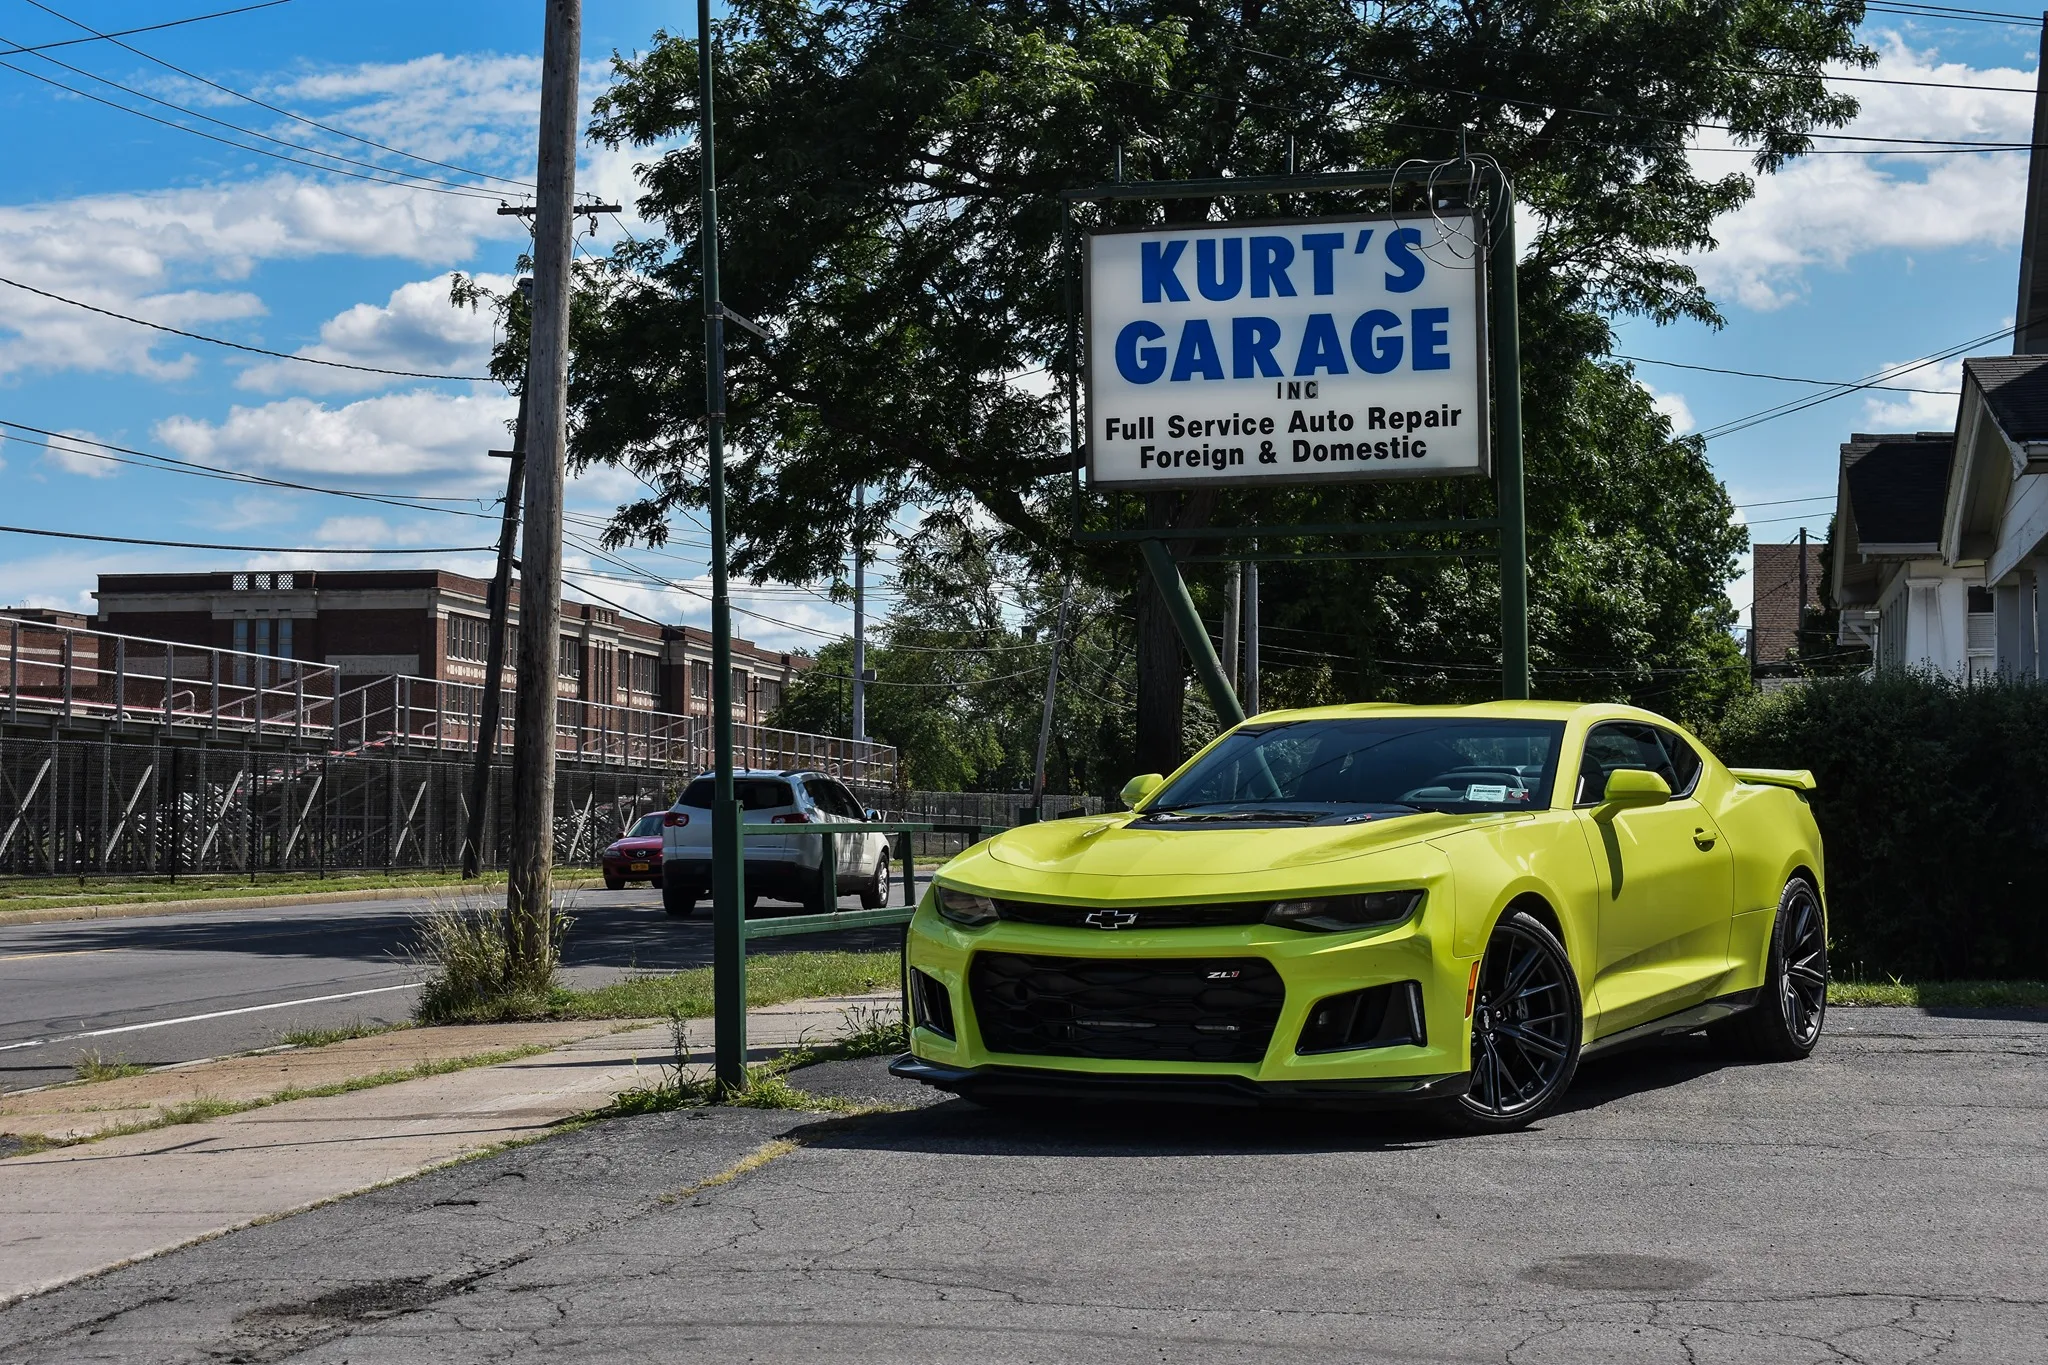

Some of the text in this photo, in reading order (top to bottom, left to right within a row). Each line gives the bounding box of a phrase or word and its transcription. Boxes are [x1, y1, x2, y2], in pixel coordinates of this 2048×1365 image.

[1141, 228, 1425, 303] KURT'S
[1115, 307, 1450, 384] GARAGE
[1277, 381, 1317, 399] INC
[1105, 404, 1462, 440] Full Service Auto Repair
[1140, 435, 1427, 470] Foreign & Domestic
[1207, 970, 1240, 979] ZL1
